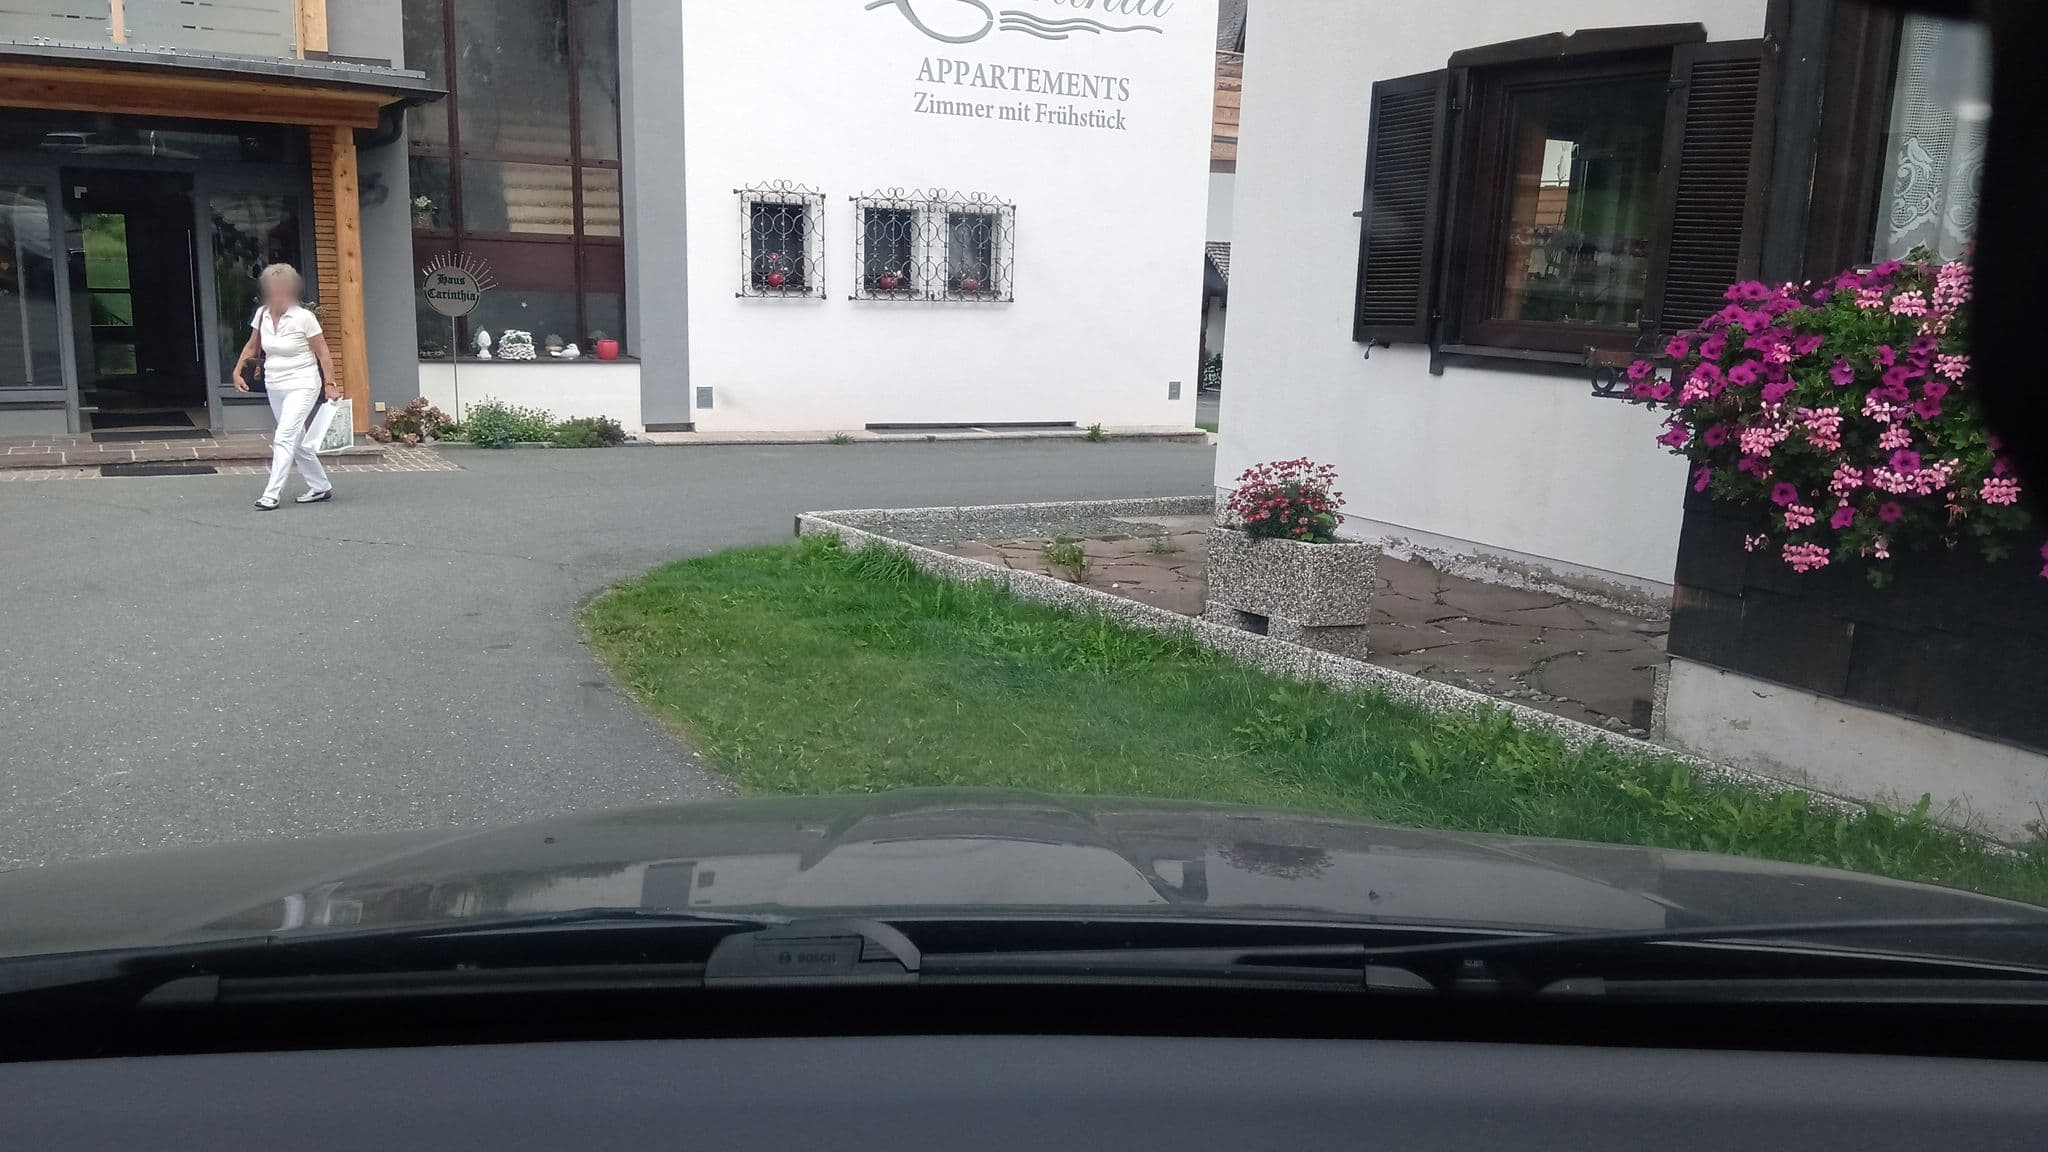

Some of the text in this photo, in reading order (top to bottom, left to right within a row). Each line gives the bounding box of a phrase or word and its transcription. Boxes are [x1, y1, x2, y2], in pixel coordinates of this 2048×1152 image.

[916, 57, 1130, 102] APPARTEMENTS
[913, 91, 1127, 131] Zimmer mit Frühstück
[437, 273, 466, 286] Haus
[427, 288, 476, 302] Carinthia
